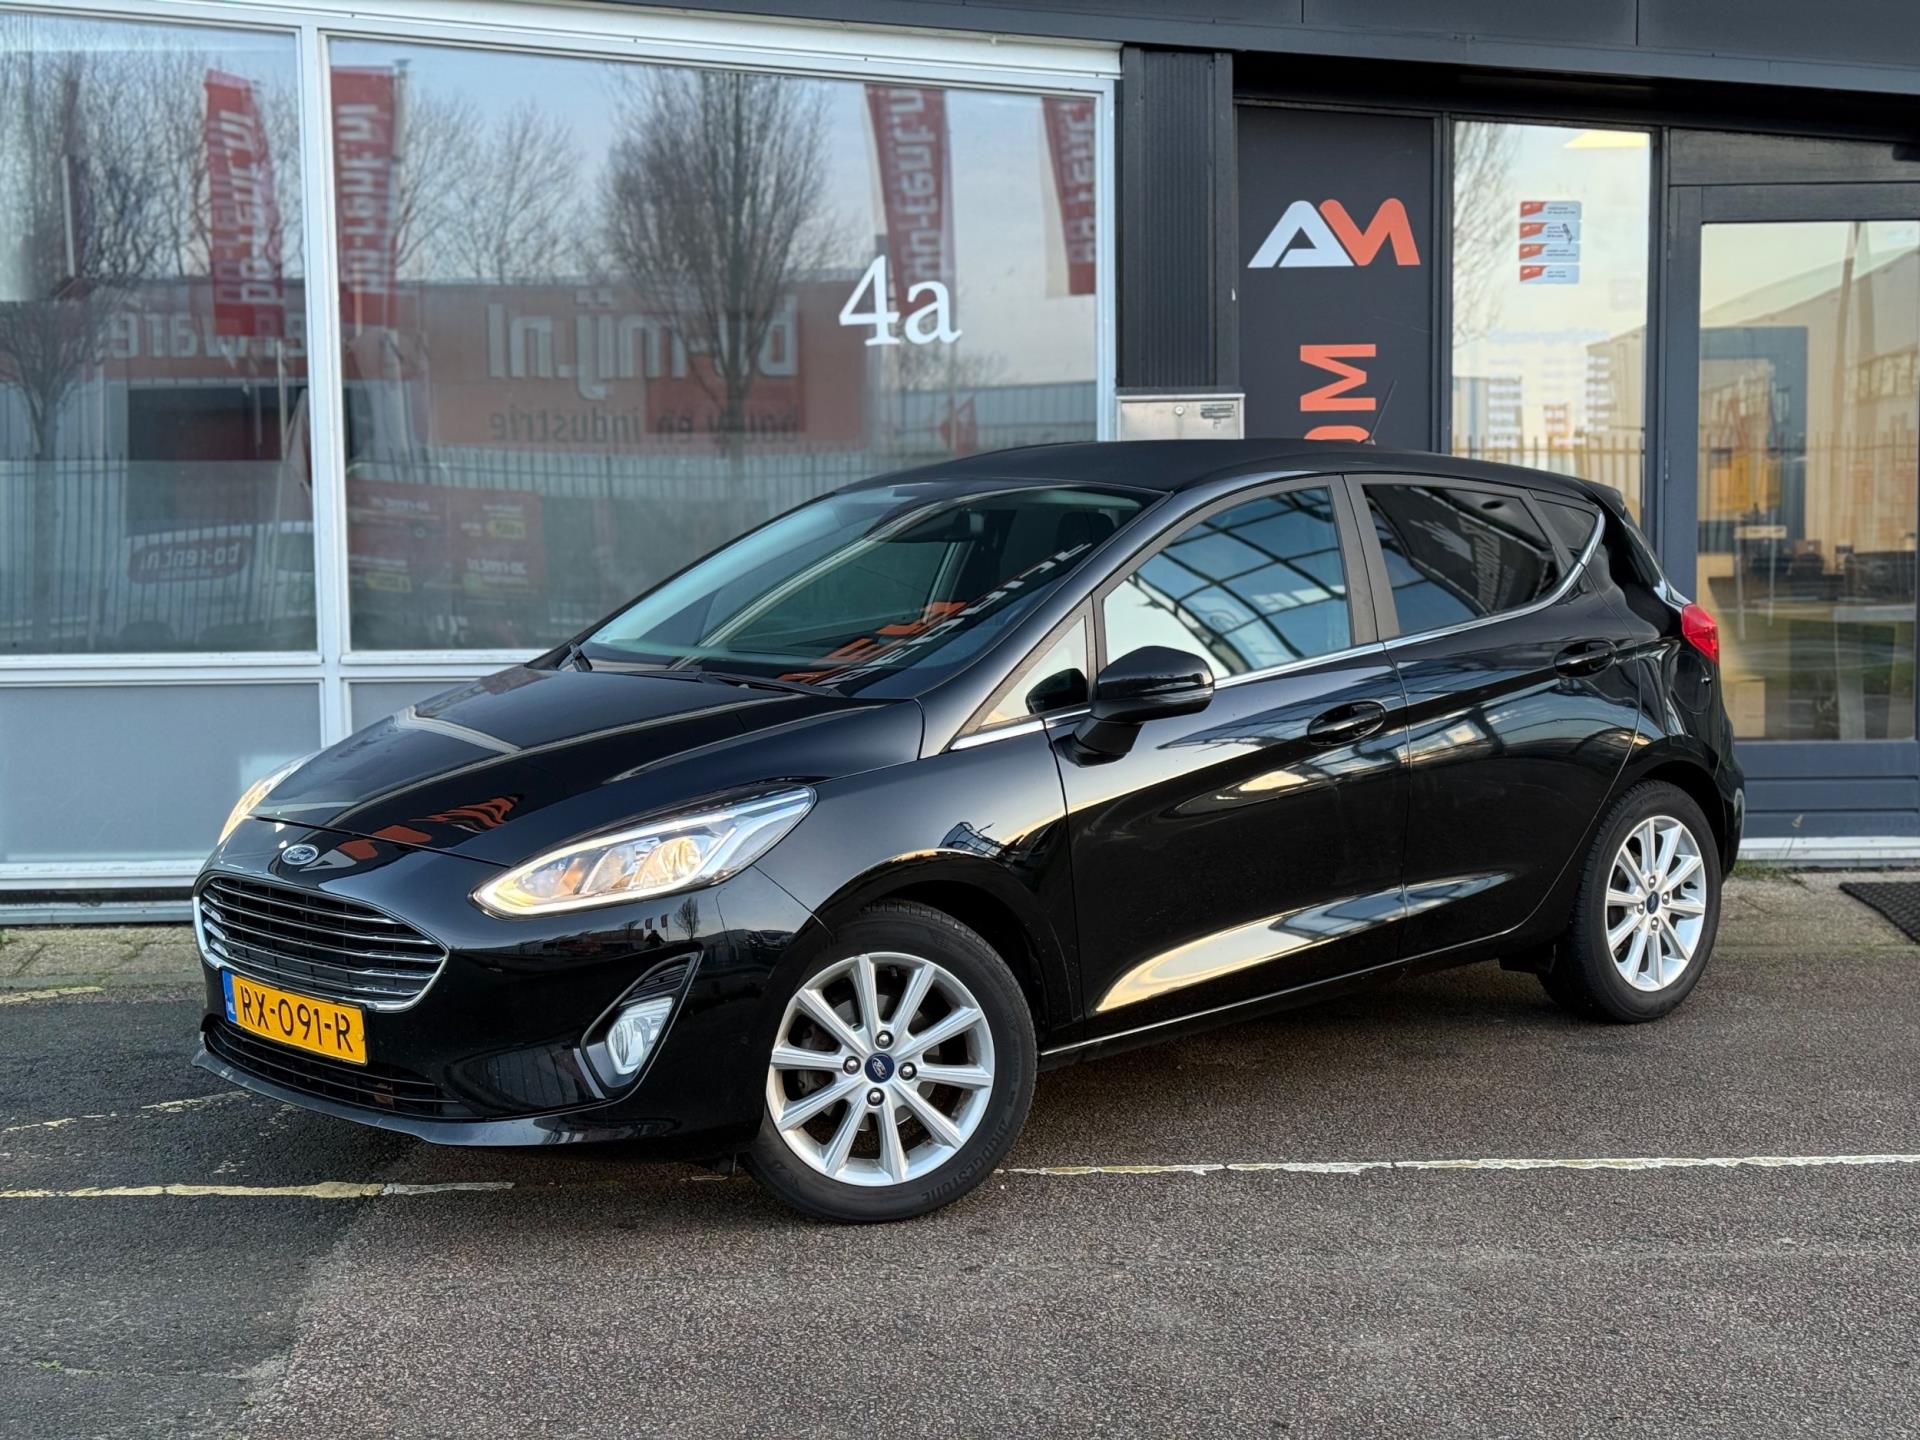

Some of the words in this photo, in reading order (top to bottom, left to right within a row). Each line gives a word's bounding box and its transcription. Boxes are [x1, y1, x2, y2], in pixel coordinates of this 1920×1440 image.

[1247, 198, 1422, 269] AM
[838, 255, 962, 347] 4a
[1300, 343, 1377, 444] M
[240, 985, 353, 1053] RX-091-R
